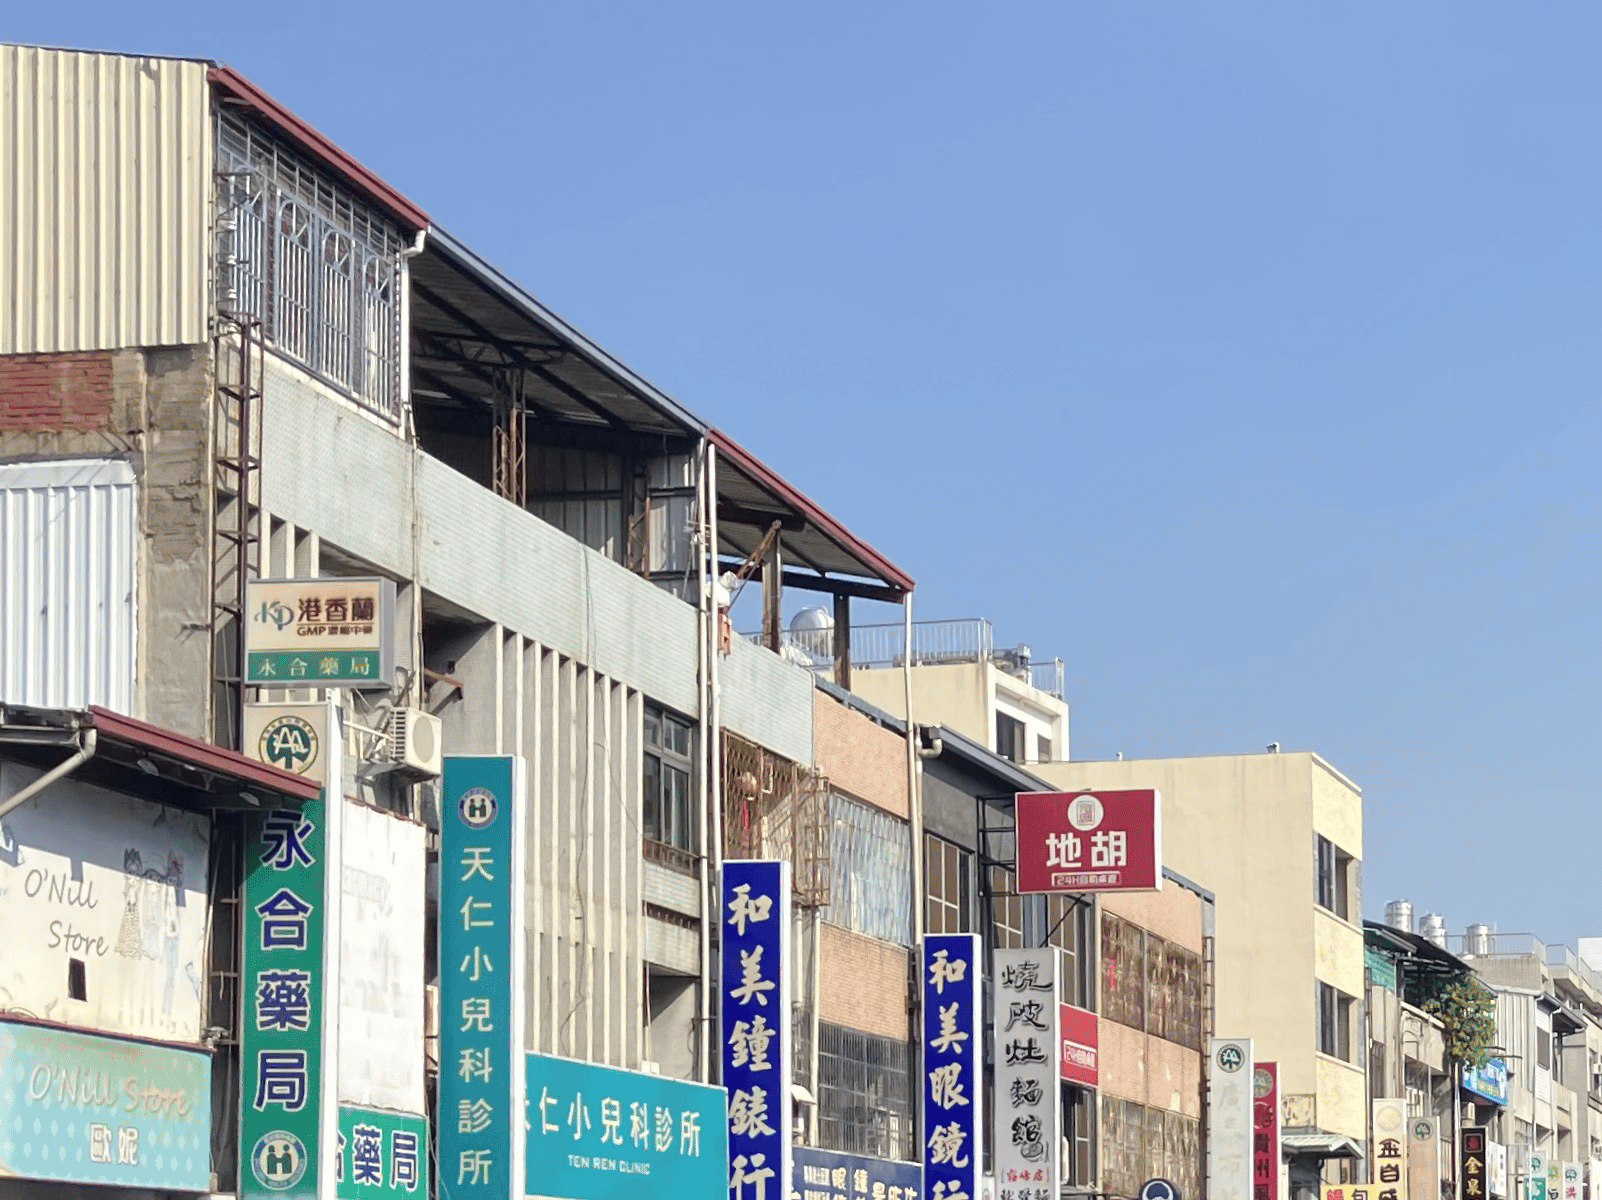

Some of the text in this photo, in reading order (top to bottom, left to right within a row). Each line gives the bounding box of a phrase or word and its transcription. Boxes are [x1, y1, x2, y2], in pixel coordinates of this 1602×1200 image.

[298, 597, 374, 622] 港香蘭
[297, 626, 326, 636] GMP
[258, 657, 370, 677] 永合藥局
[1045, 830, 1126, 867] 地胡
[24, 868, 98, 909] O'Nill
[48, 920, 109, 957] Store
[253, 809, 316, 1113] 永合藥局
[457, 847, 495, 1186] 天仁小兒科診所
[31, 1063, 192, 1117] O'Nill Store
[90, 1123, 139, 1166] 歐妮
[567, 1154, 650, 1175] TEN REN CLINIC
